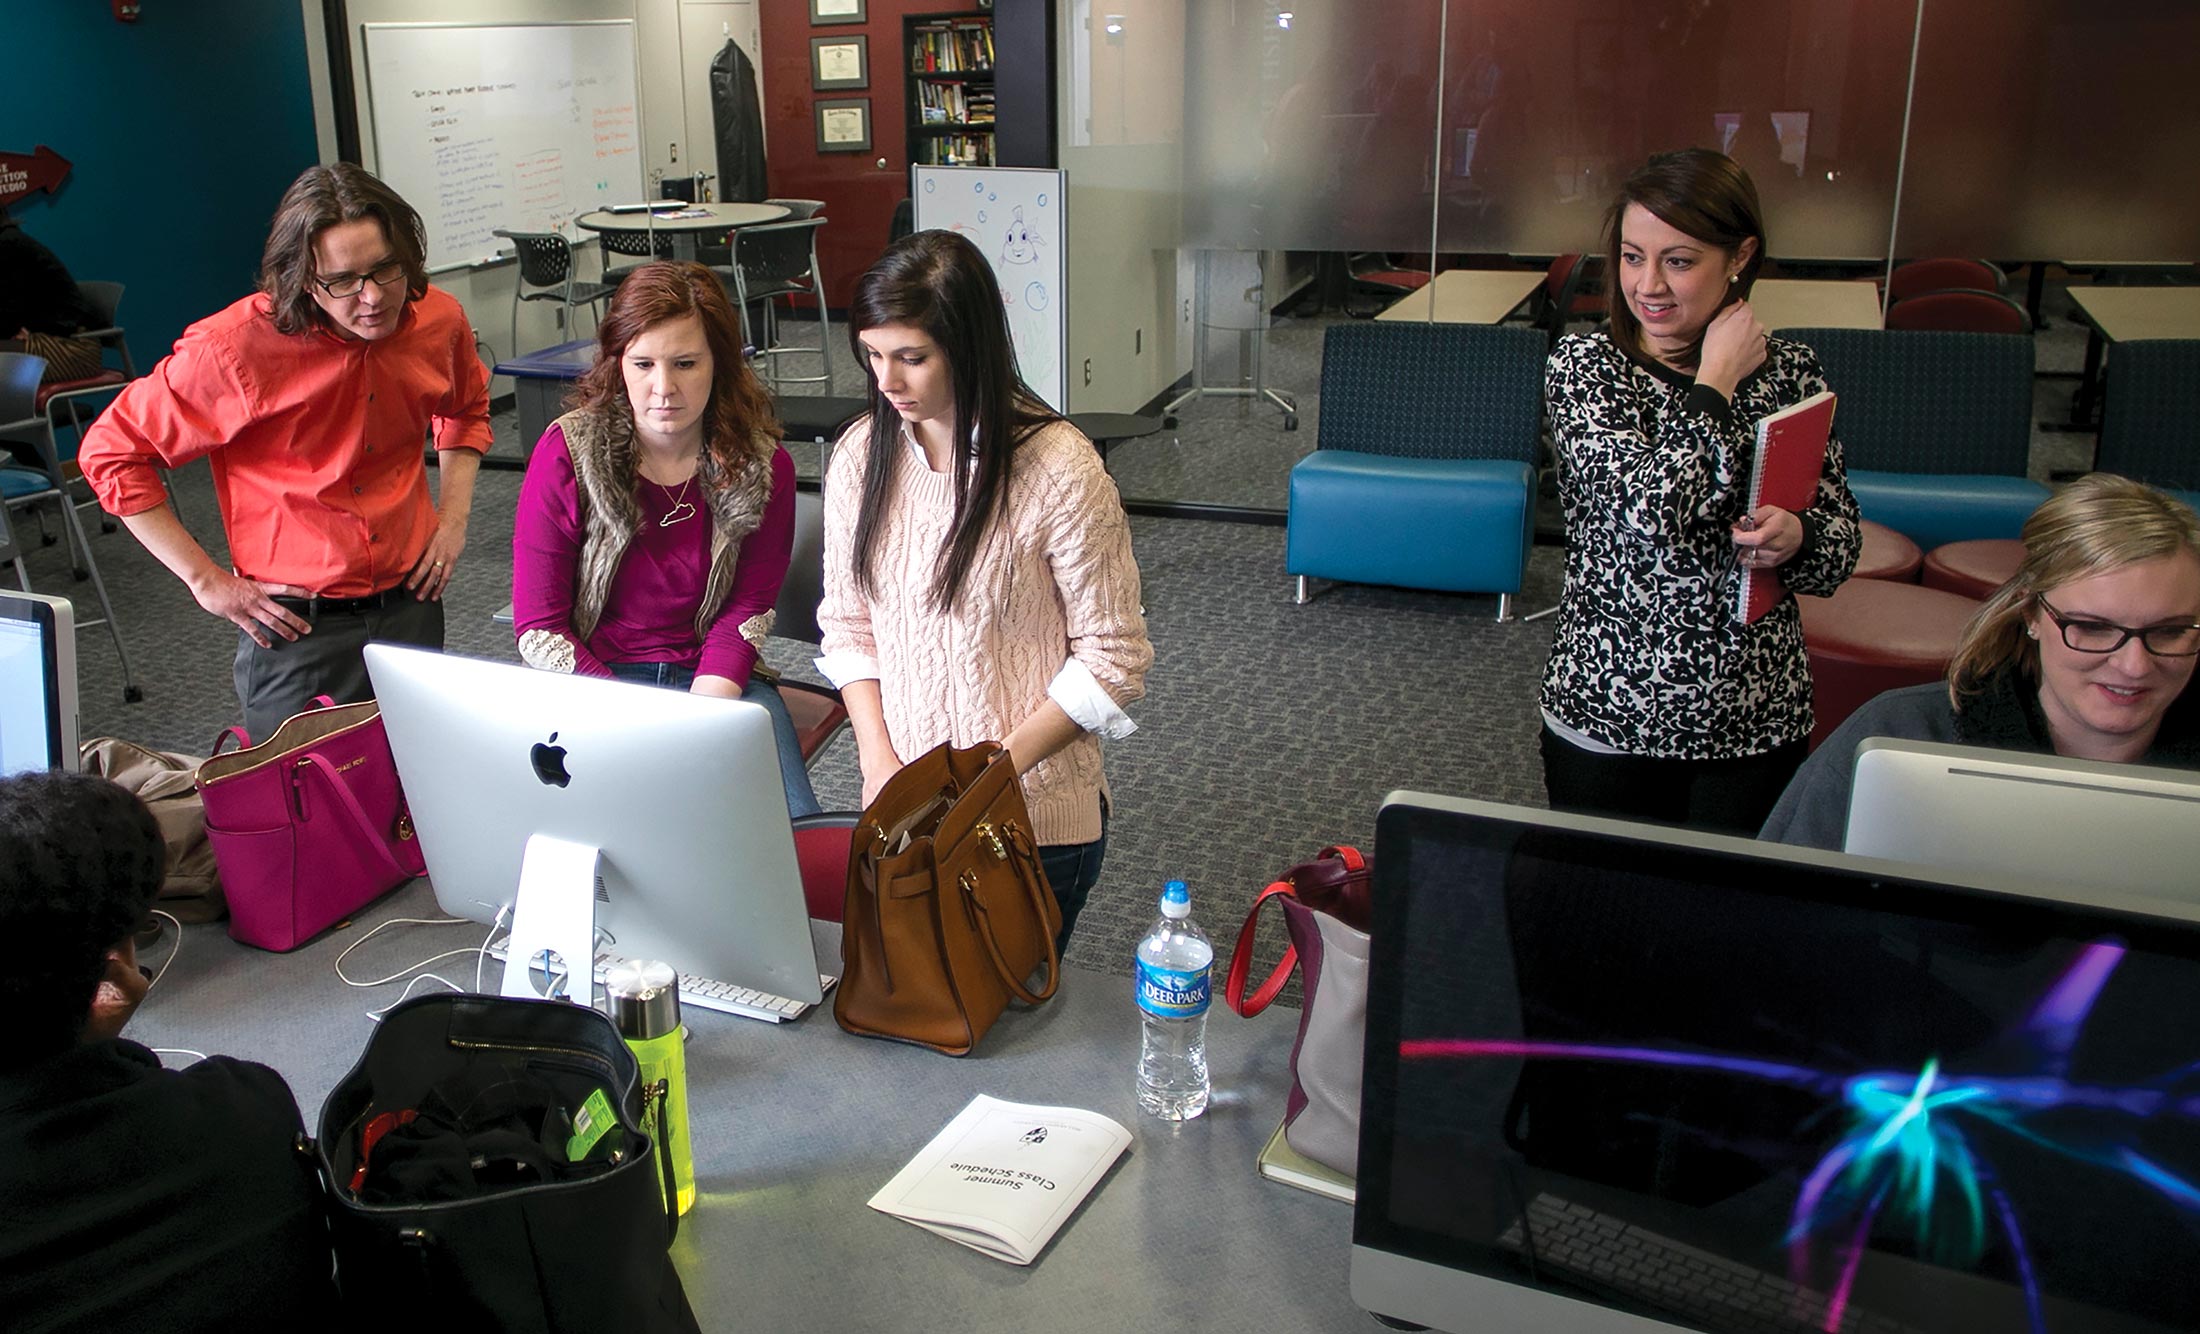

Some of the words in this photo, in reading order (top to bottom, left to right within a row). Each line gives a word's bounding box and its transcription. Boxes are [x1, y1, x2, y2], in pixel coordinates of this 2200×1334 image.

[1145, 980, 1176, 1004] DEER
[1177, 985, 1205, 1004] PARK
[950, 1162, 1014, 1178] Schedule
[963, 1174, 1024, 1191] Summer
[1017, 1171, 1056, 1191] Class
